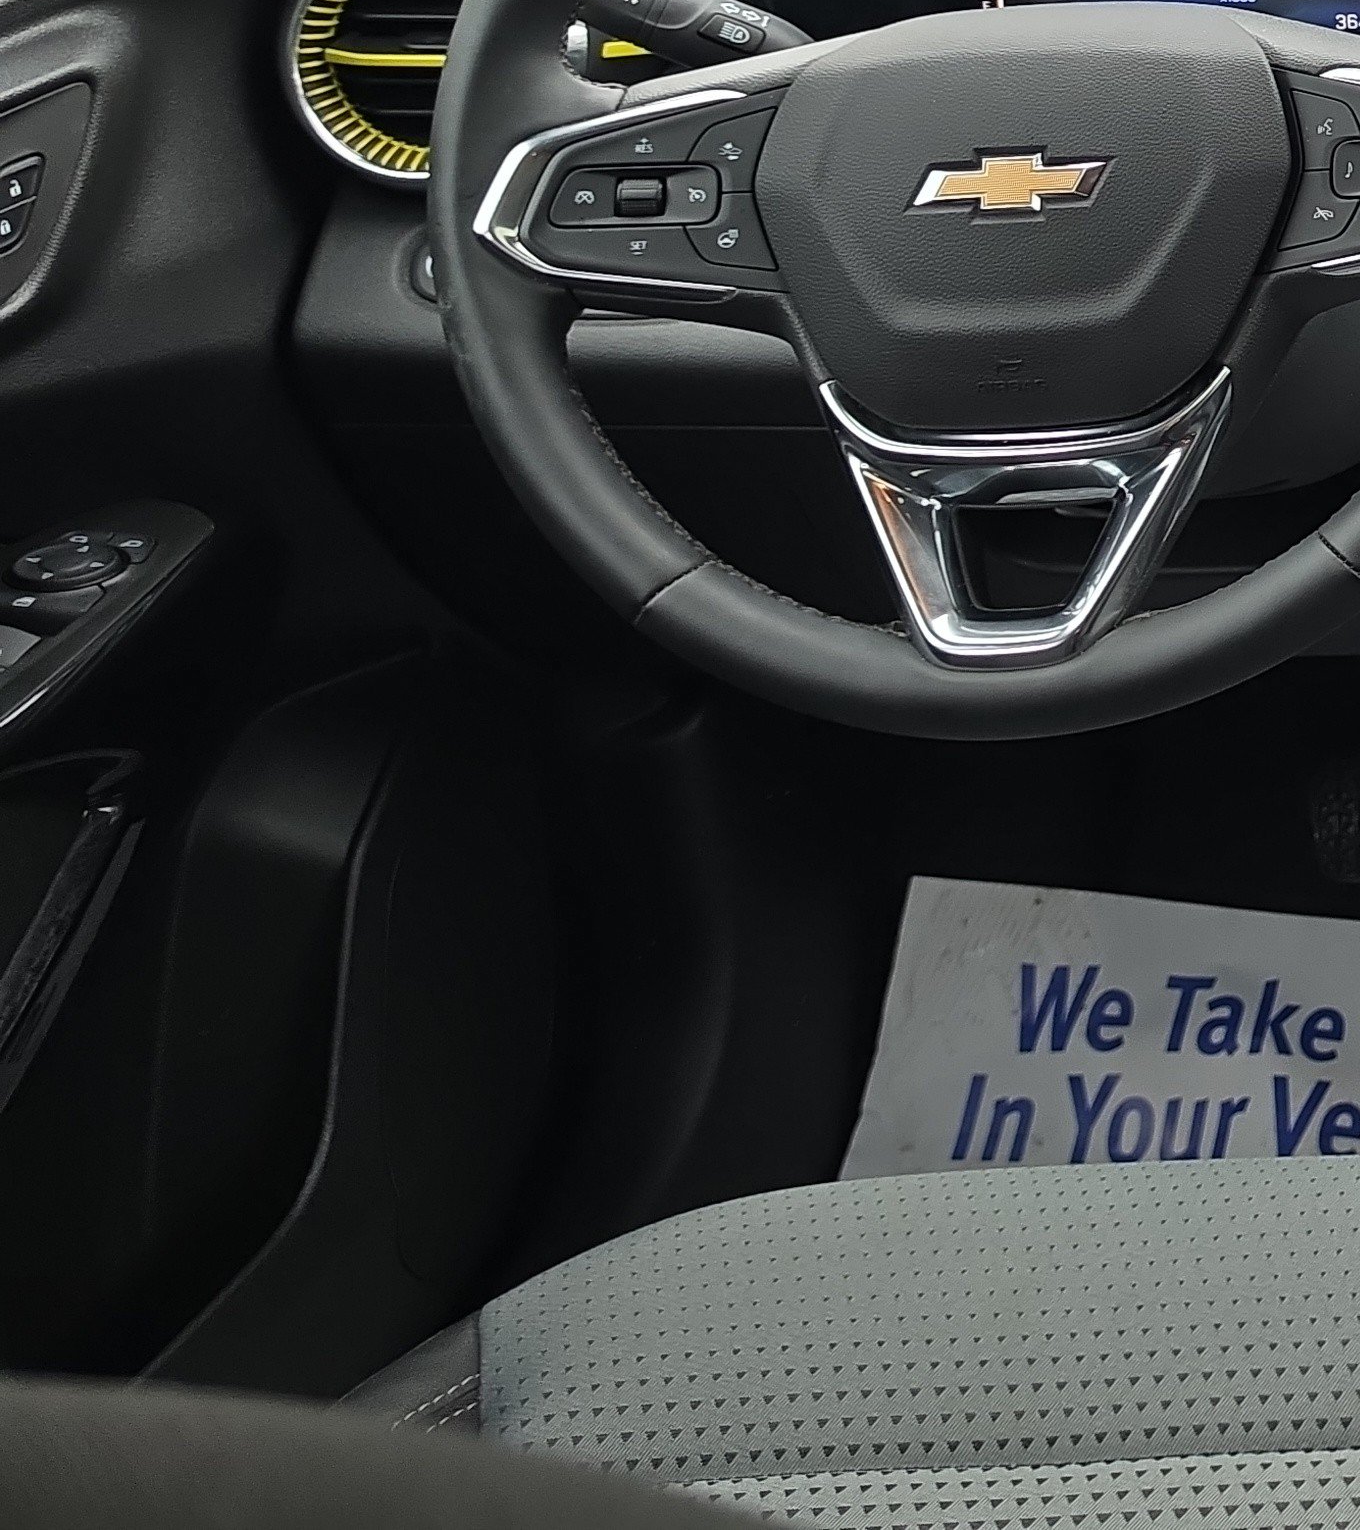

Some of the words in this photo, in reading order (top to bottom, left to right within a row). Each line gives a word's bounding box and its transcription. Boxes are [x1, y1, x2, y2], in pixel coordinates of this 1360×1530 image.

[635, 143, 653, 154] RES
[629, 240, 647, 251] SET
[1017, 962, 1135, 1054] We
[1165, 975, 1347, 1064] Take
[950, 1073, 1036, 1163] In
[1065, 1074, 1252, 1164] Your
